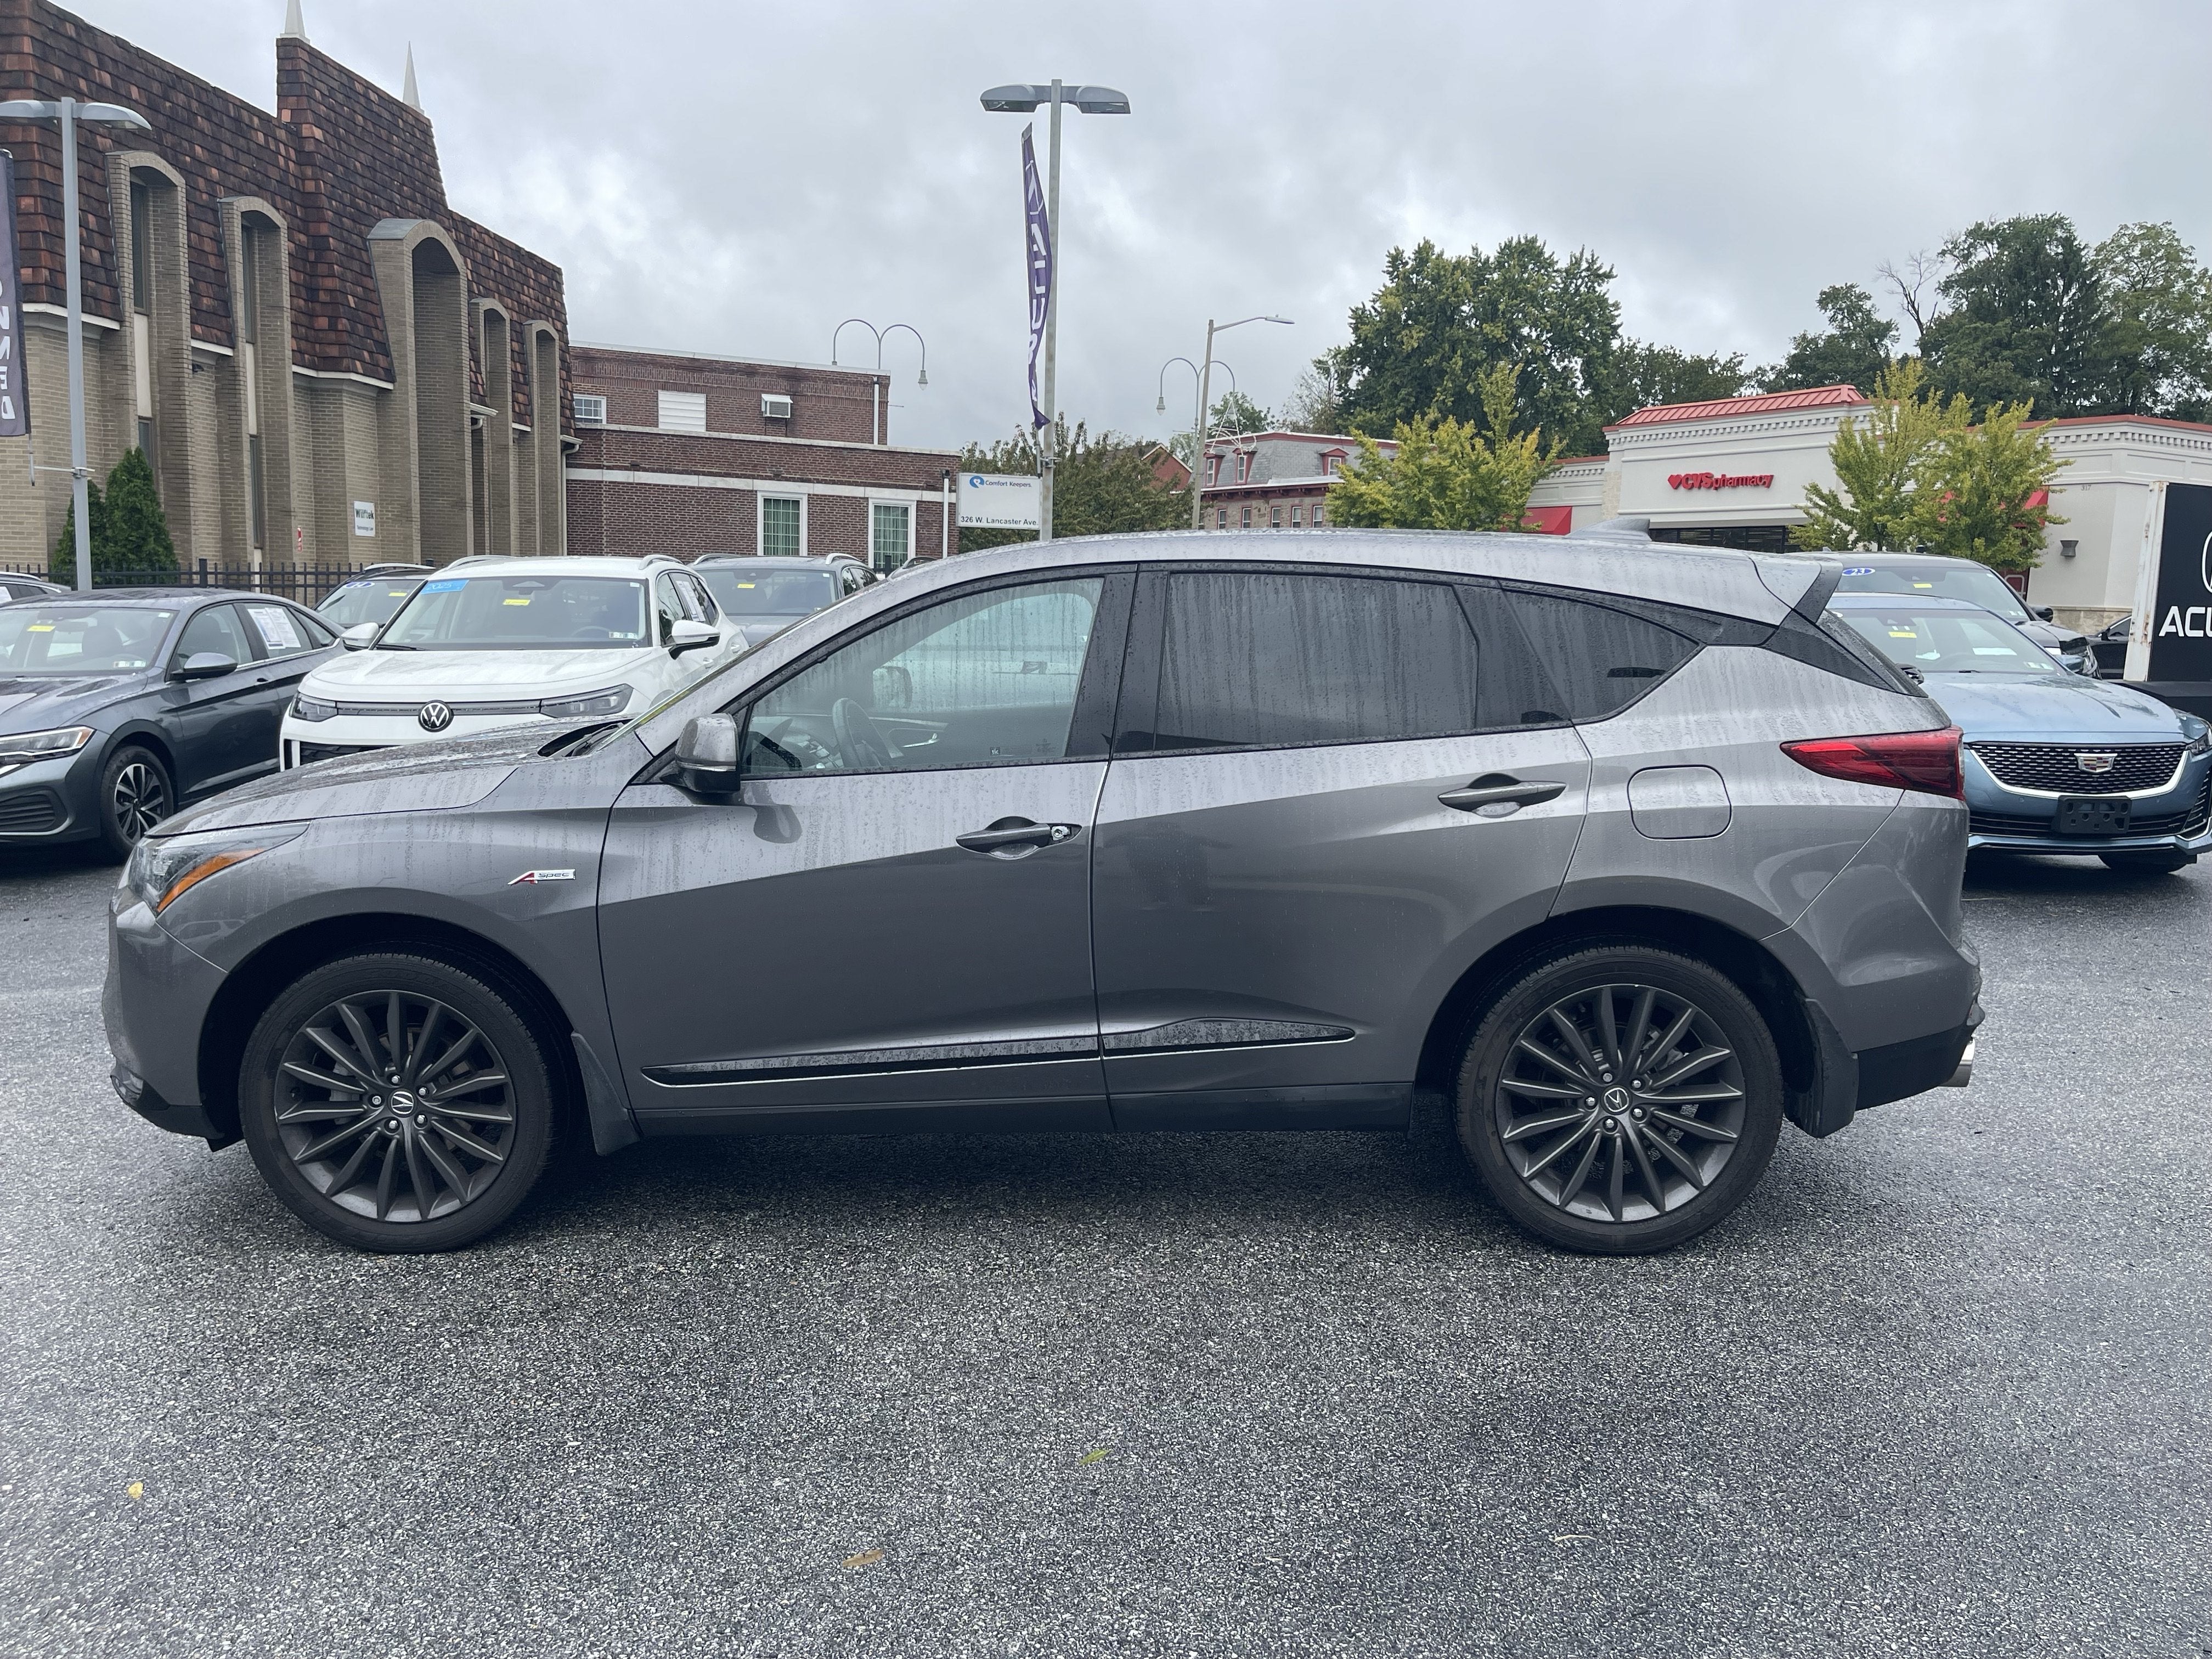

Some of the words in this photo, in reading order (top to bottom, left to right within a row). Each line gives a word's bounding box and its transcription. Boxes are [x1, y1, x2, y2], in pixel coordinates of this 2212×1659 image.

[1681, 472, 1714, 489] CVS
[1713, 474, 1774, 490] pharmacy
[1852, 567, 1865, 575] 23
